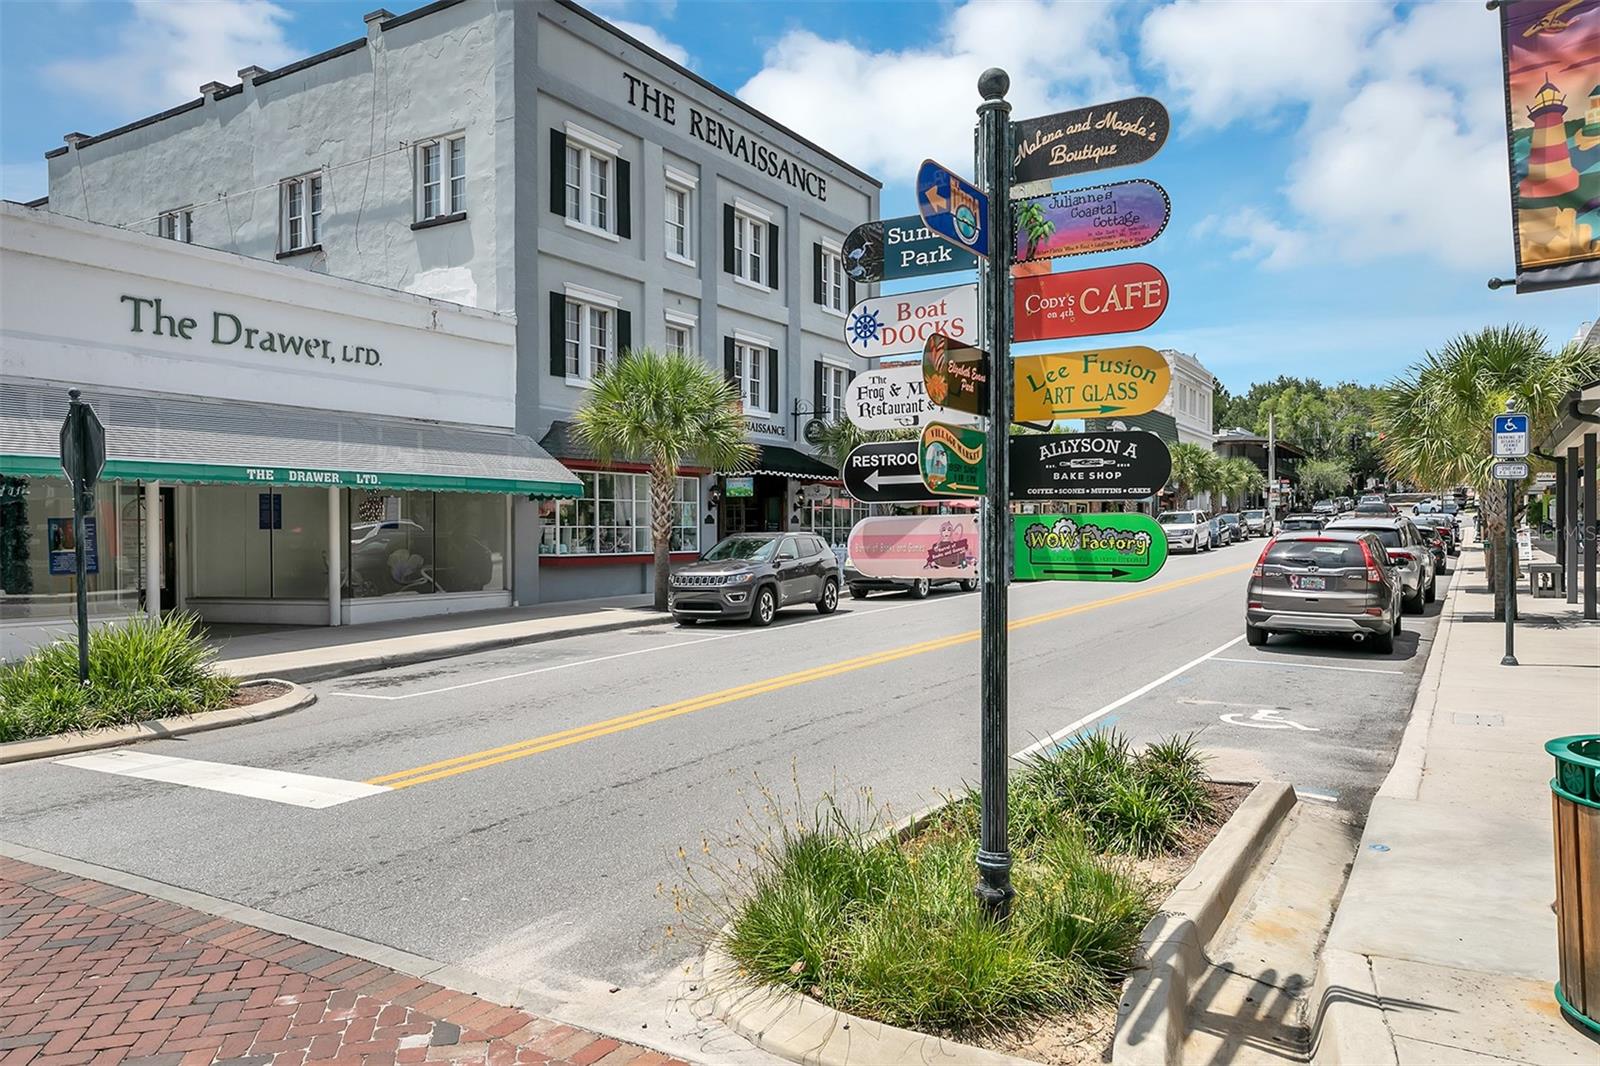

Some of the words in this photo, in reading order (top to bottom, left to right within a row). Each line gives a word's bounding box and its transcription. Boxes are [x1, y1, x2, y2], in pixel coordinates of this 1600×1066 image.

[623, 72, 676, 126] THE
[689, 108, 826, 202] RENAISSANCE
[1066, 112, 1093, 135] and
[1095, 111, 1157, 142] Magda's
[1049, 144, 1117, 166] Boutique
[1049, 188, 1113, 209] Julianne's
[1071, 201, 1117, 219] Coastal
[1093, 211, 1140, 227] Cottage
[900, 245, 952, 267] Park
[1080, 279, 1161, 314] CAFE
[897, 299, 947, 321] Boat
[1047, 311, 1057, 319] on
[1060, 308, 1074, 320] 4th
[120, 295, 197, 340] The
[211, 311, 335, 363] Drawer,
[342, 345, 383, 366] LTD.
[882, 318, 964, 346] DOCKS
[869, 376, 887, 384] The
[1026, 366, 1070, 392] Lee
[1082, 354, 1157, 384] Fusion
[857, 385, 884, 401] Frog
[889, 383, 901, 397] &
[961, 378, 974, 393] Park
[1042, 386, 1075, 405] ART
[1082, 381, 1138, 403] GLASS
[857, 398, 924, 418] Restaurant
[852, 453, 917, 467] RESTROO
[1039, 438, 1121, 461] ALLYSON
[1123, 442, 1137, 459] A
[247, 469, 274, 480] THE
[356, 474, 381, 485] LTD.
[1053, 472, 1084, 480] BAKE
[1089, 471, 1122, 479] SHOP
[1030, 531, 1078, 548] WOW
[1081, 531, 1146, 555] Factory
